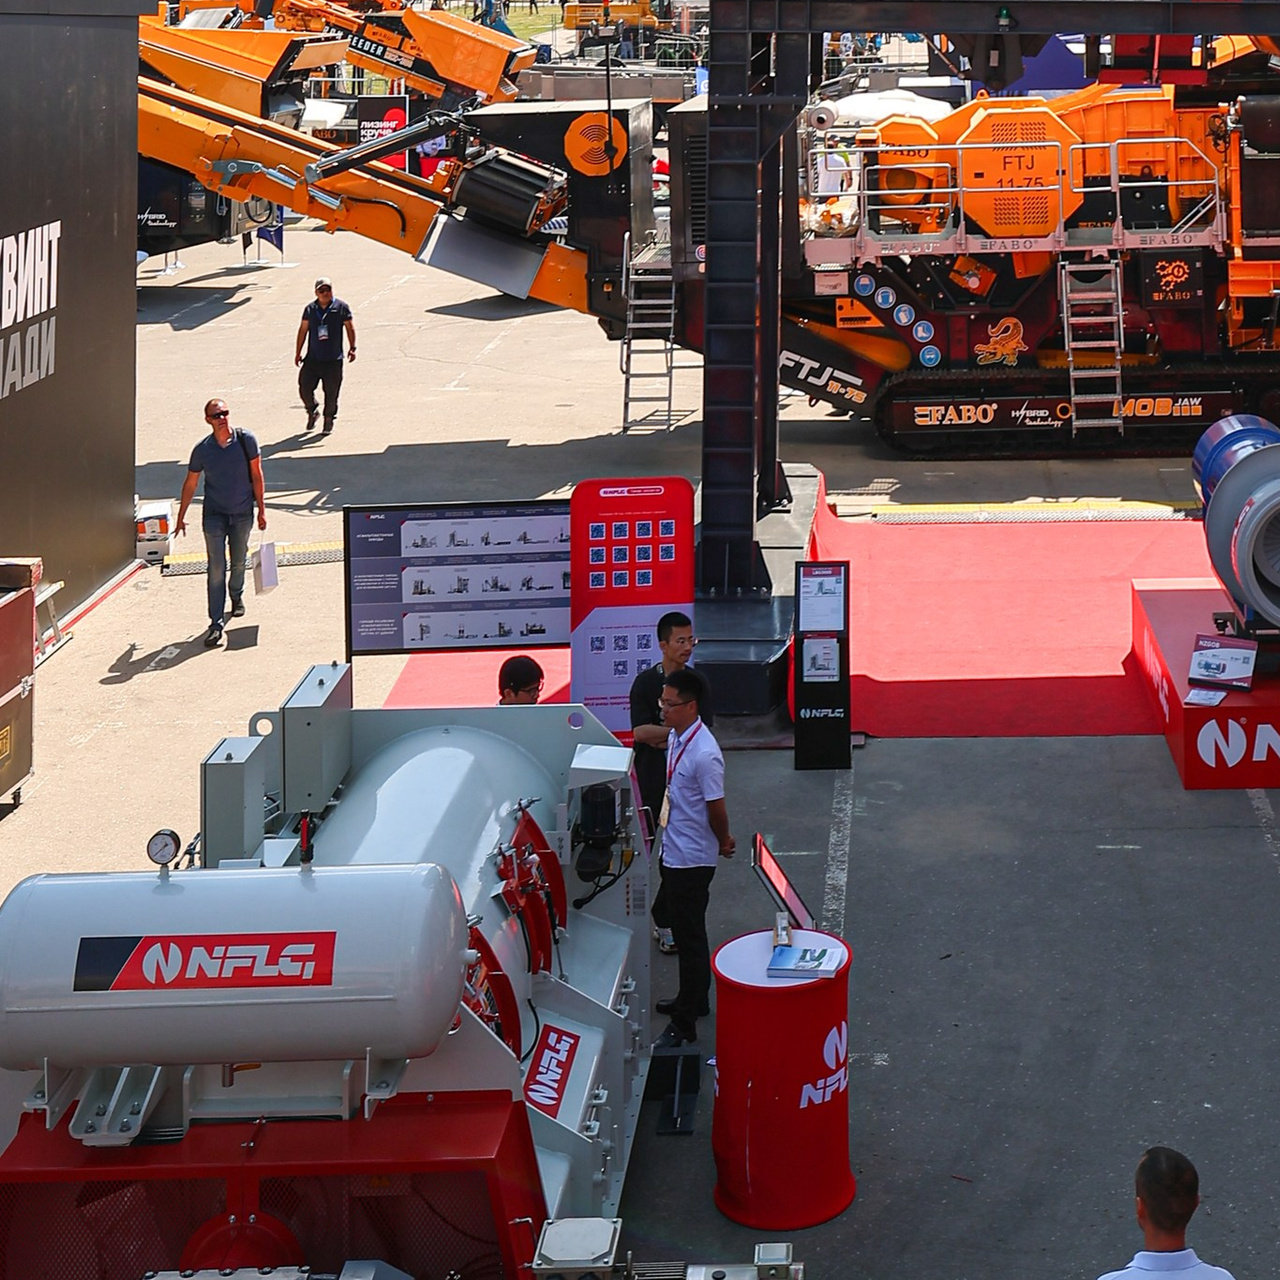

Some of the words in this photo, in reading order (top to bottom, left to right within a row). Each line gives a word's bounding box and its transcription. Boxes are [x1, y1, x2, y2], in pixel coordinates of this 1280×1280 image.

[360, 120, 399, 130] лизинг
[1002, 154, 1035, 171] FTJ
[988, 240, 1034, 251] FABO
[1147, 234, 1194, 246] FABO
[0, 220, 62, 331] ВИНТ
[0, 315, 57, 400] АДИ
[825, 378, 868, 405] 11-75
[927, 403, 996, 426] FABO
[1112, 397, 1173, 417] MOB
[1176, 397, 1202, 407] JAW
[811, 708, 845, 719] NFLG
[184, 943, 316, 980] NFLG
[534, 1030, 576, 1090] NFLG
